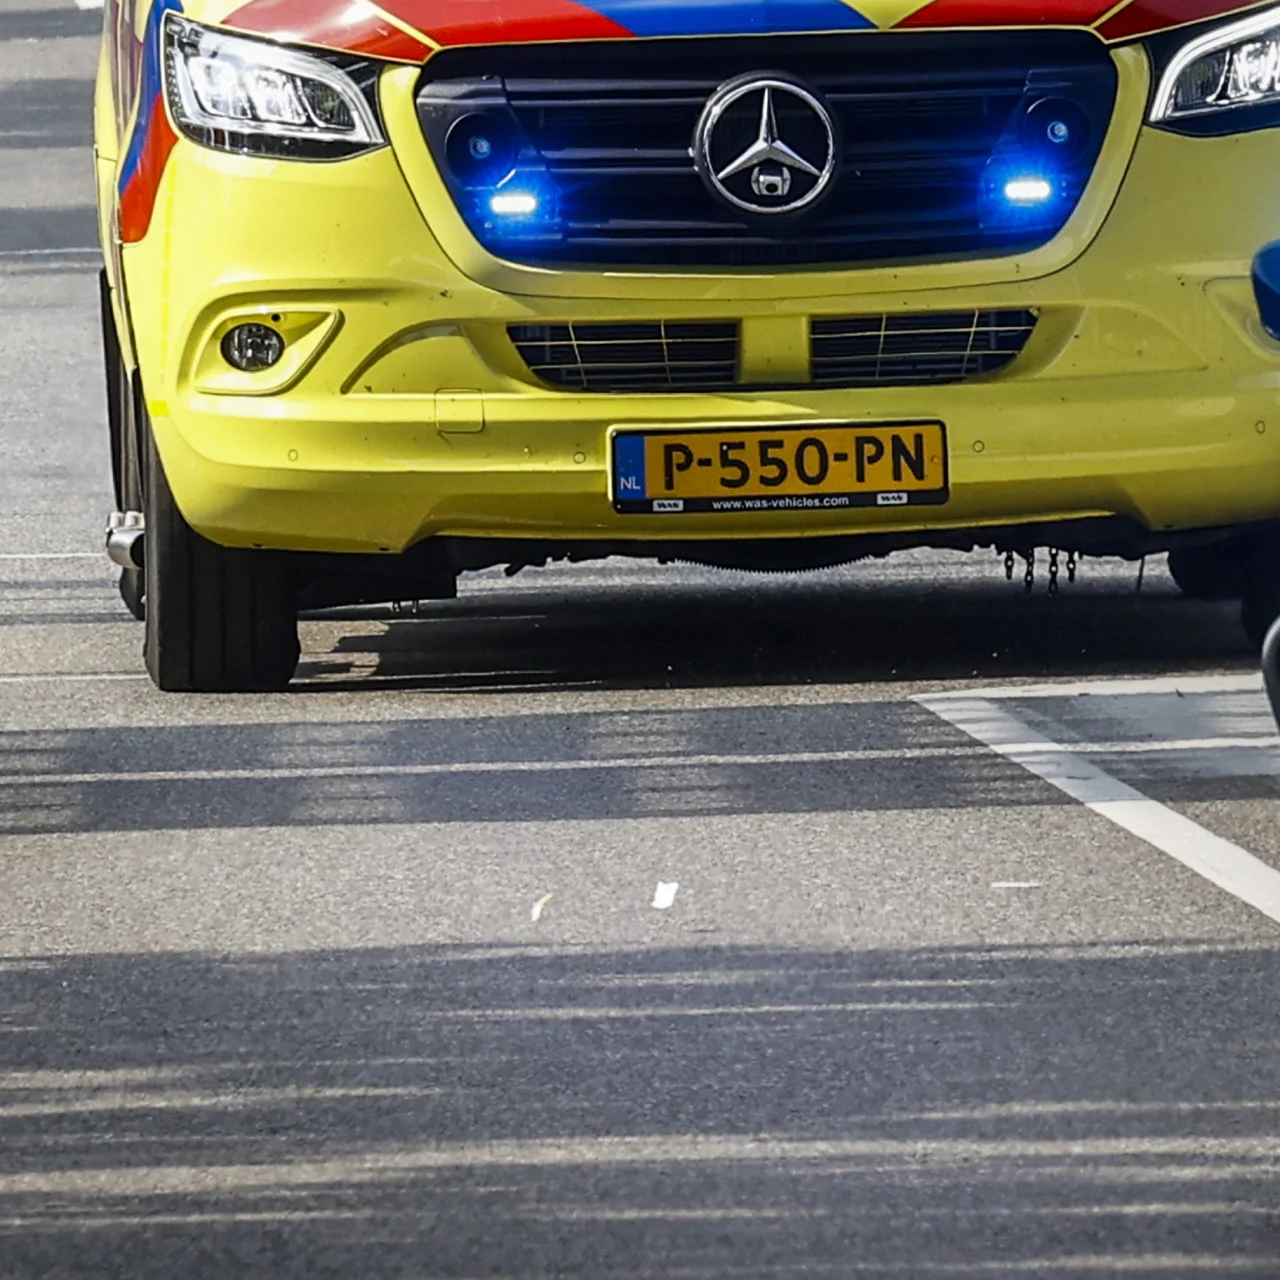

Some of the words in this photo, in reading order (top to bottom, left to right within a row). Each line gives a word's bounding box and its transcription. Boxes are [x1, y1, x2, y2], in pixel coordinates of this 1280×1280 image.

[663, 433, 926, 491] P-550-PN
[620, 476, 641, 490] NL
[712, 496, 850, 510] www.was-vehicles.com
